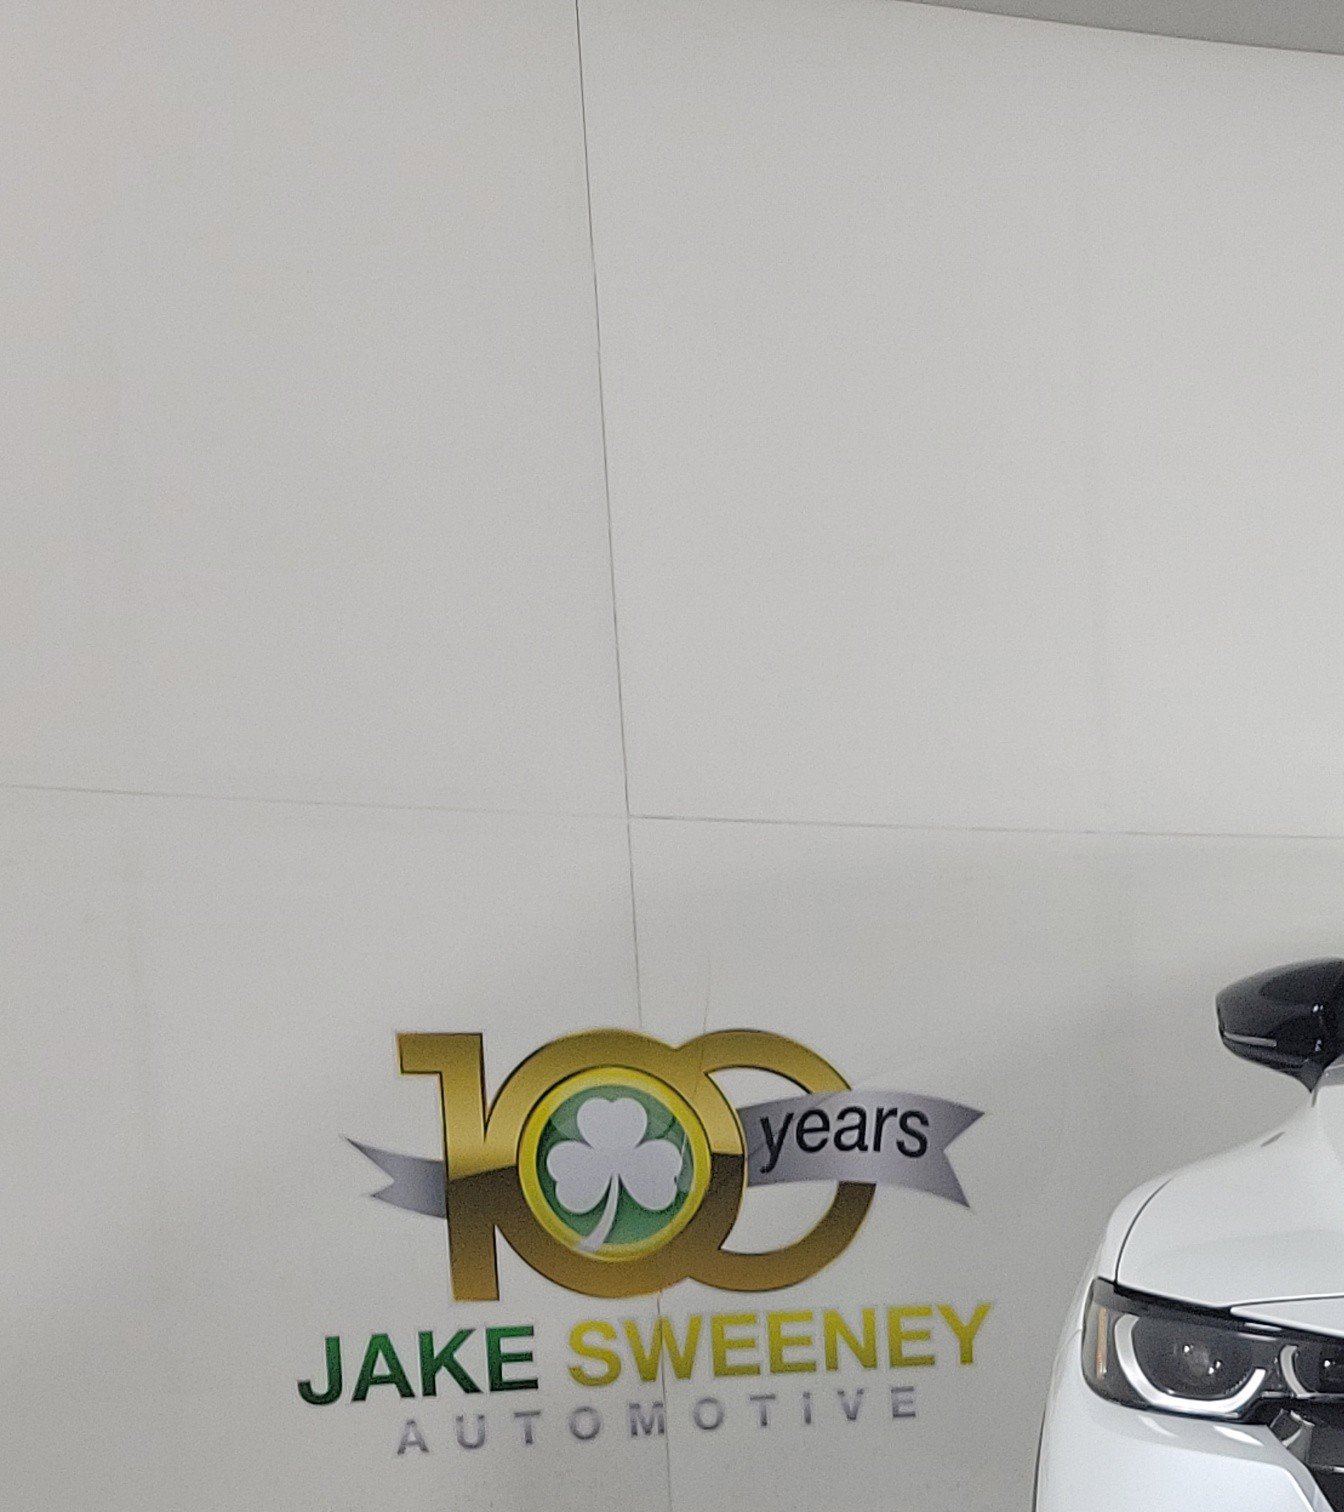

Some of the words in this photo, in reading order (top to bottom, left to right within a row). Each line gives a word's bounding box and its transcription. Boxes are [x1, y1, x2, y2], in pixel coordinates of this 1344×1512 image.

[397, 1029, 875, 1301] 100
[759, 1105, 930, 1173] years
[298, 1325, 538, 1407] JAKE
[567, 1303, 991, 1387] SWEENEY
[396, 1386, 918, 1455] AUTOMOTIVE
